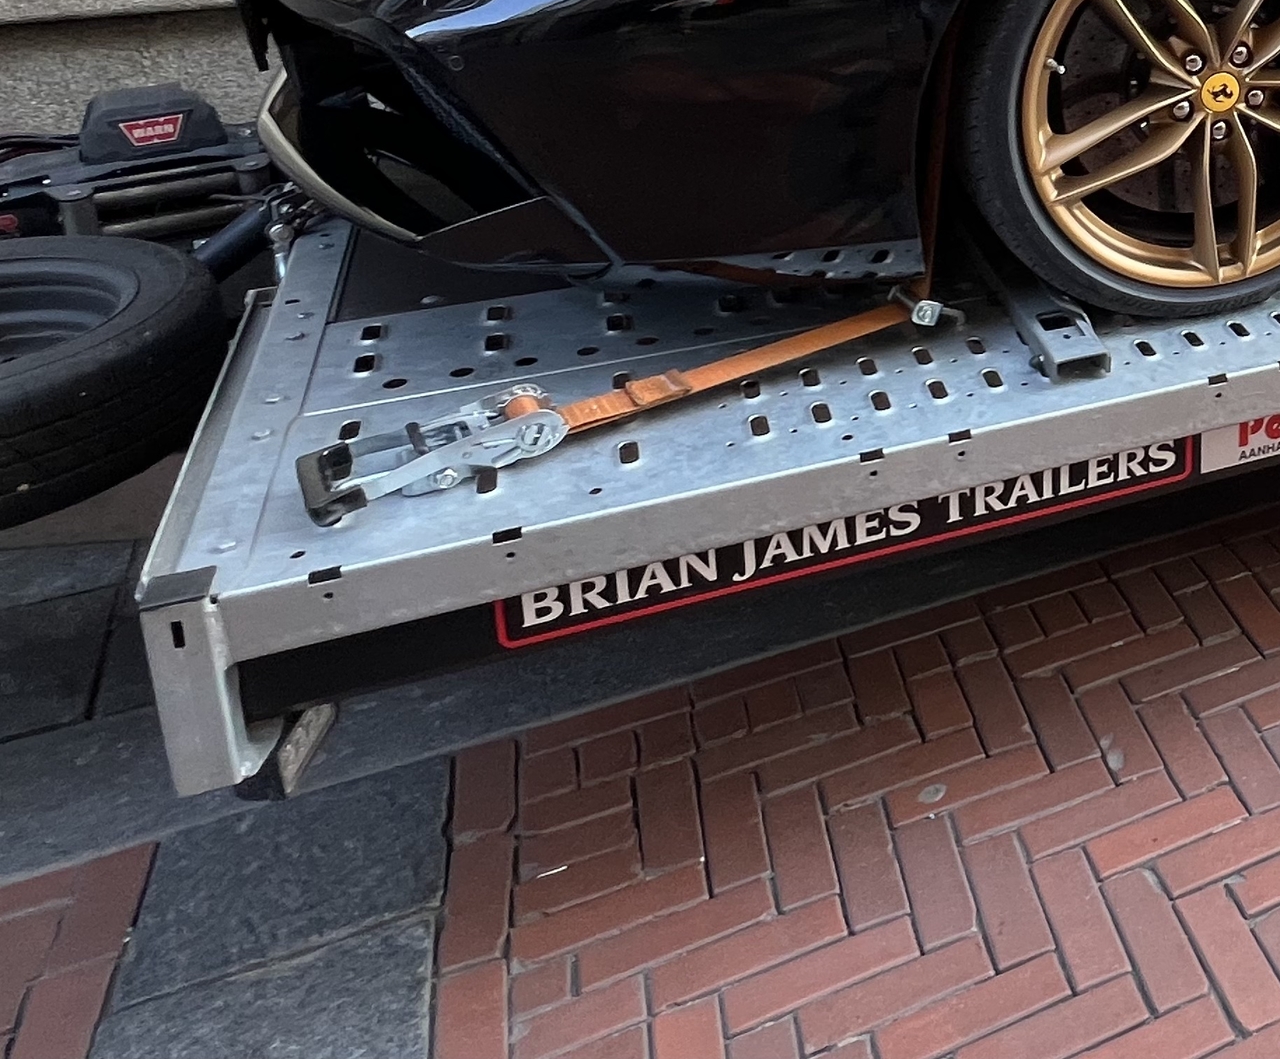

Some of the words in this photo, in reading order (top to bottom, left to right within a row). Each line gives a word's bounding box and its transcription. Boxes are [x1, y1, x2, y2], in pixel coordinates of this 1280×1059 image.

[521, 548, 718, 628] BRIAN
[732, 499, 921, 582] JAMES
[938, 440, 1177, 524] TRAILERS
